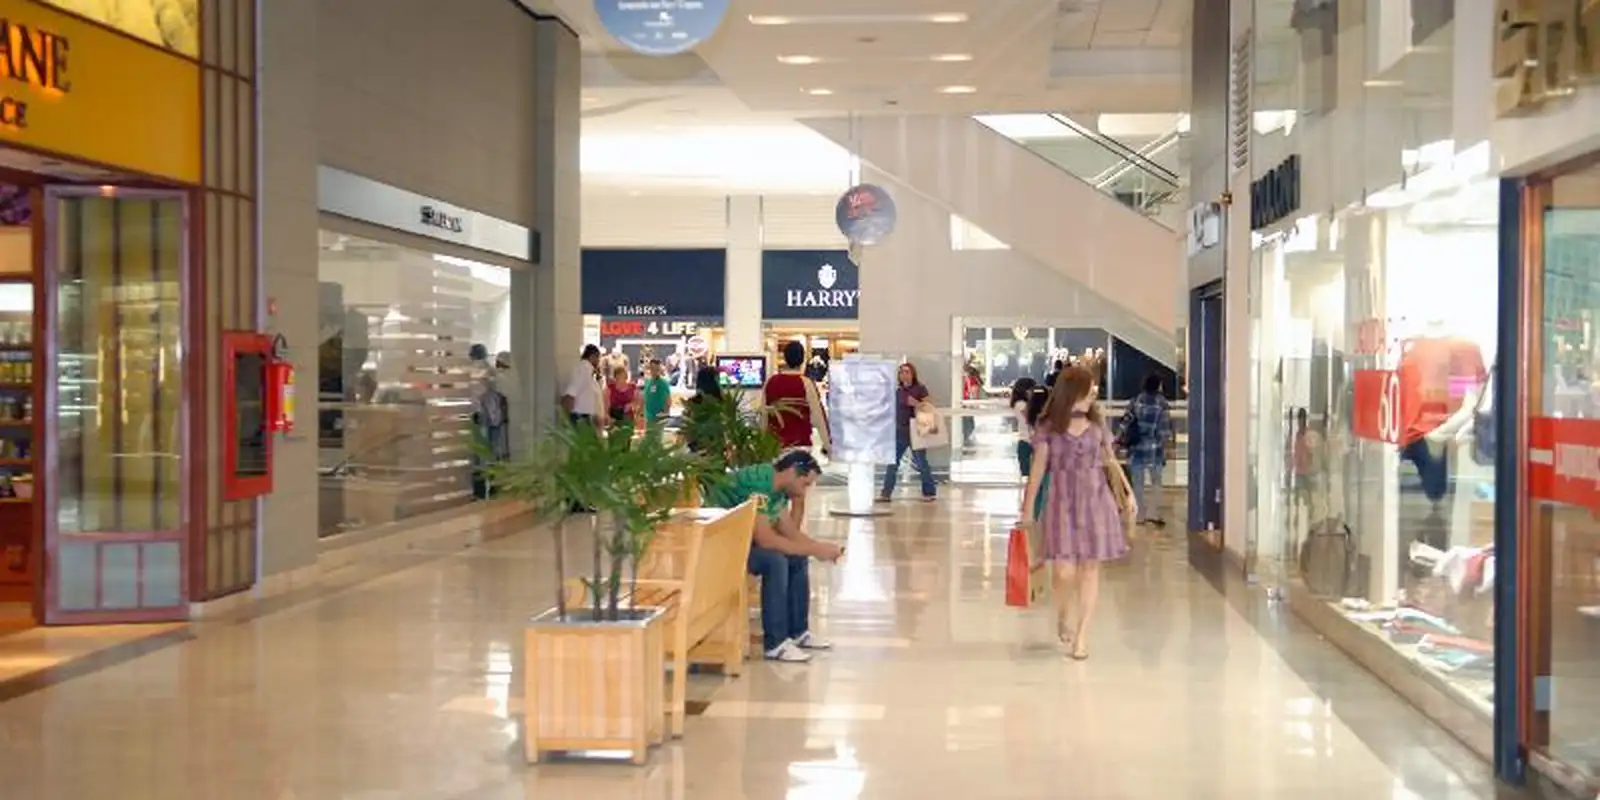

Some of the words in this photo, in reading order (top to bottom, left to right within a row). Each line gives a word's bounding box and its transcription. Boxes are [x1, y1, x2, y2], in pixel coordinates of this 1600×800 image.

[617, 304, 667, 315] HARRY'S
[601, 321, 645, 336] LOVE
[647, 320, 659, 335] 4
[662, 321, 697, 335] LIFE
